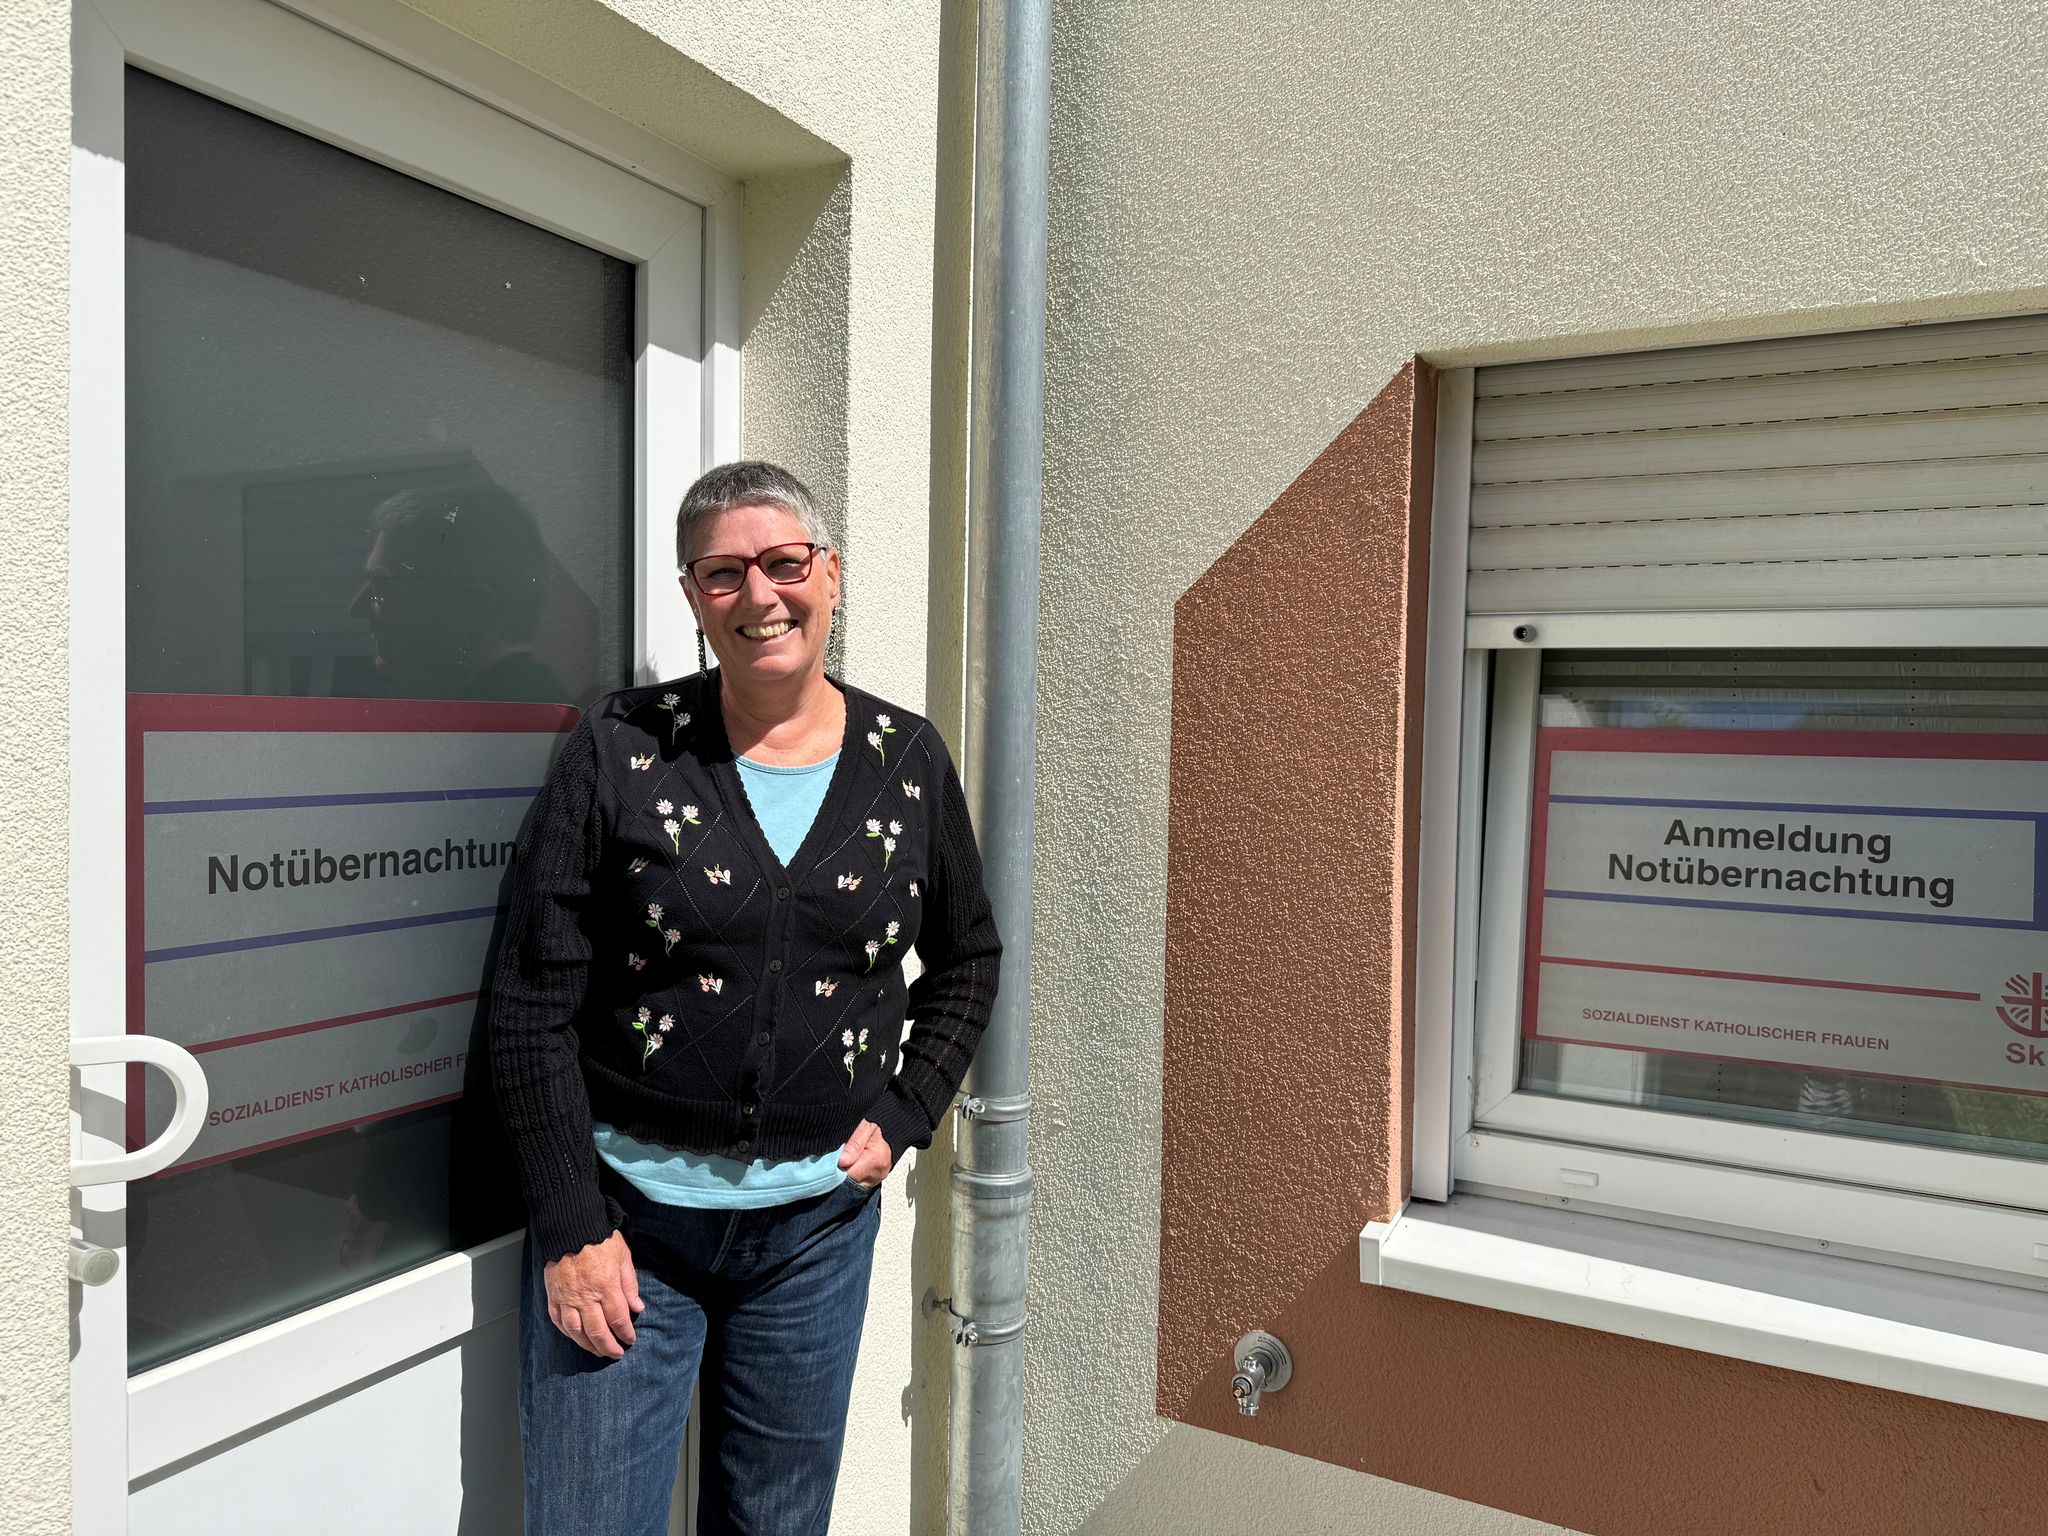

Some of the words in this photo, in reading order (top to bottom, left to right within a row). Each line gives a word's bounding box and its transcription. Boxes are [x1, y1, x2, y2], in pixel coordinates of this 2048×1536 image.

[1663, 819, 1891, 863] Anmeldung
[208, 838, 518, 894] Notübernachtun
[1608, 853, 1955, 908] Notübernachtung
[1582, 1008, 1690, 1029] SOZIALDIENST
[1694, 1020, 1816, 1043] KATHOLISCHER
[1822, 1033, 1889, 1051] FRAUEN
[2006, 1042, 2046, 1066] Sk
[208, 1084, 334, 1127] SOZIALDIENST
[339, 1056, 452, 1096] KATHOLISCHER
